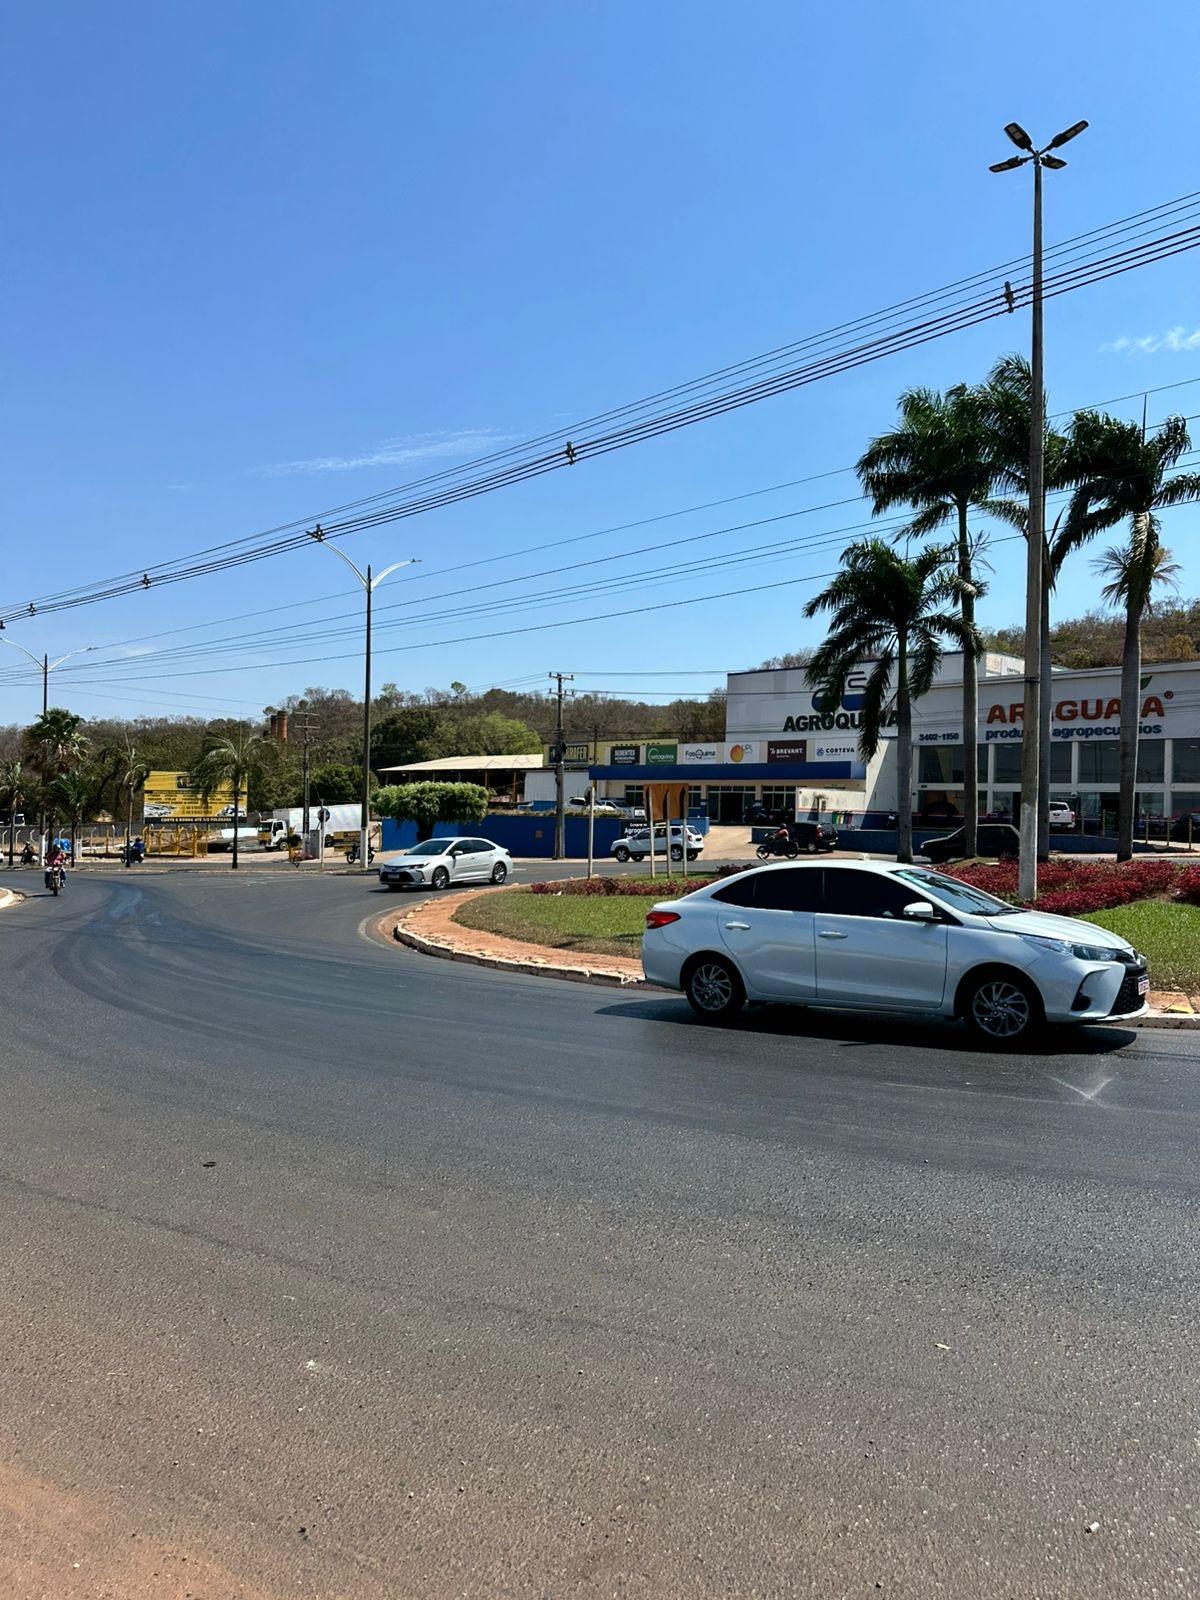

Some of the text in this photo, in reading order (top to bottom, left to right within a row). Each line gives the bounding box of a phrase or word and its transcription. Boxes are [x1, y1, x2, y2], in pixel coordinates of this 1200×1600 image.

[783, 710, 900, 732] AGROQUA
[987, 696, 1165, 724] ARGUAA
[986, 722, 1162, 740] produ agropecuios
